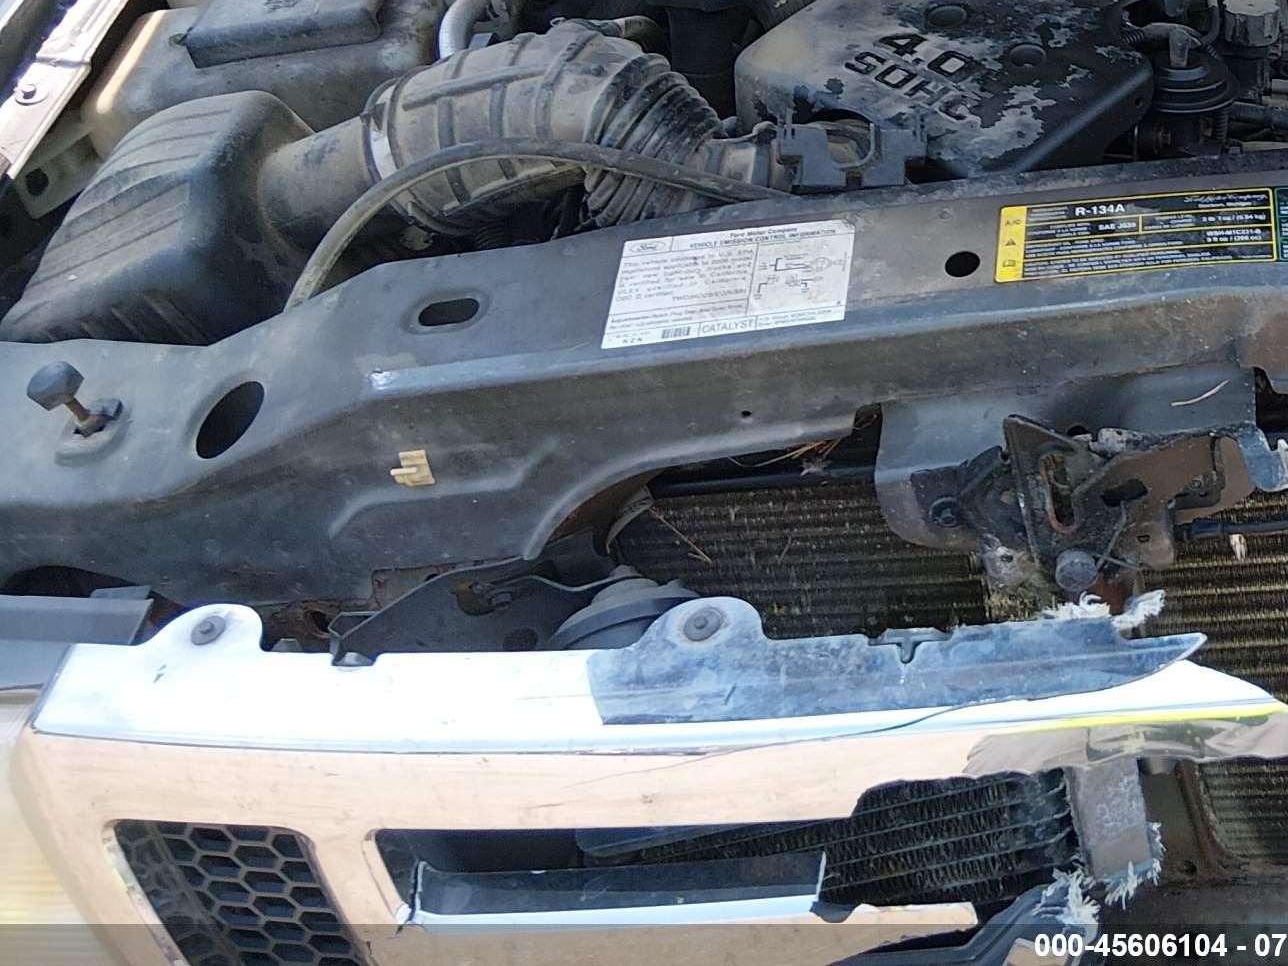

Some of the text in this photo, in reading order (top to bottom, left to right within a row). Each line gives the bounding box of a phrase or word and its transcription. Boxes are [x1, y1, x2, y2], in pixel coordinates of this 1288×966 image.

[844, 51, 968, 121] SOHC
[1075, 204, 1125, 216] R-134A
[755, 234, 786, 242] CONTROL
[702, 319, 753, 333] CATALYST
